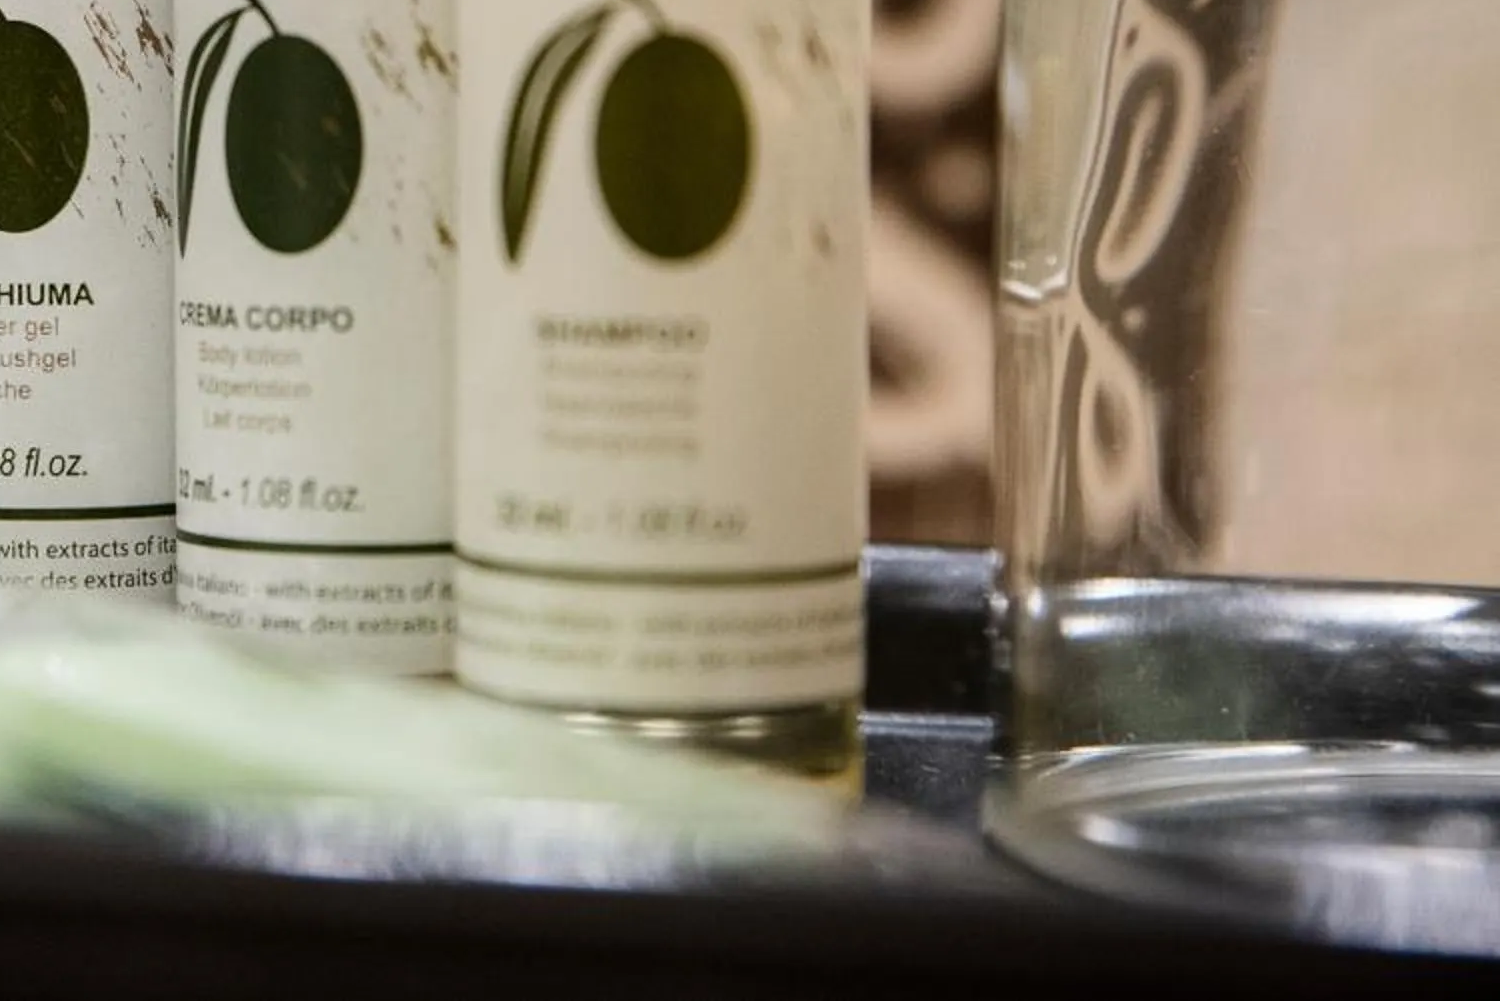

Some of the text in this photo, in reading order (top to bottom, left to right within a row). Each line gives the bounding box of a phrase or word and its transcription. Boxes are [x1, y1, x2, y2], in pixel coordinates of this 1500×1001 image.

[24, 316, 60, 341] gel
[179, 300, 355, 334] CREMA CORPO
[45, 539, 130, 560] extracts
[134, 534, 156, 557] of
[41, 570, 78, 591] des
[84, 567, 158, 590] extraits
